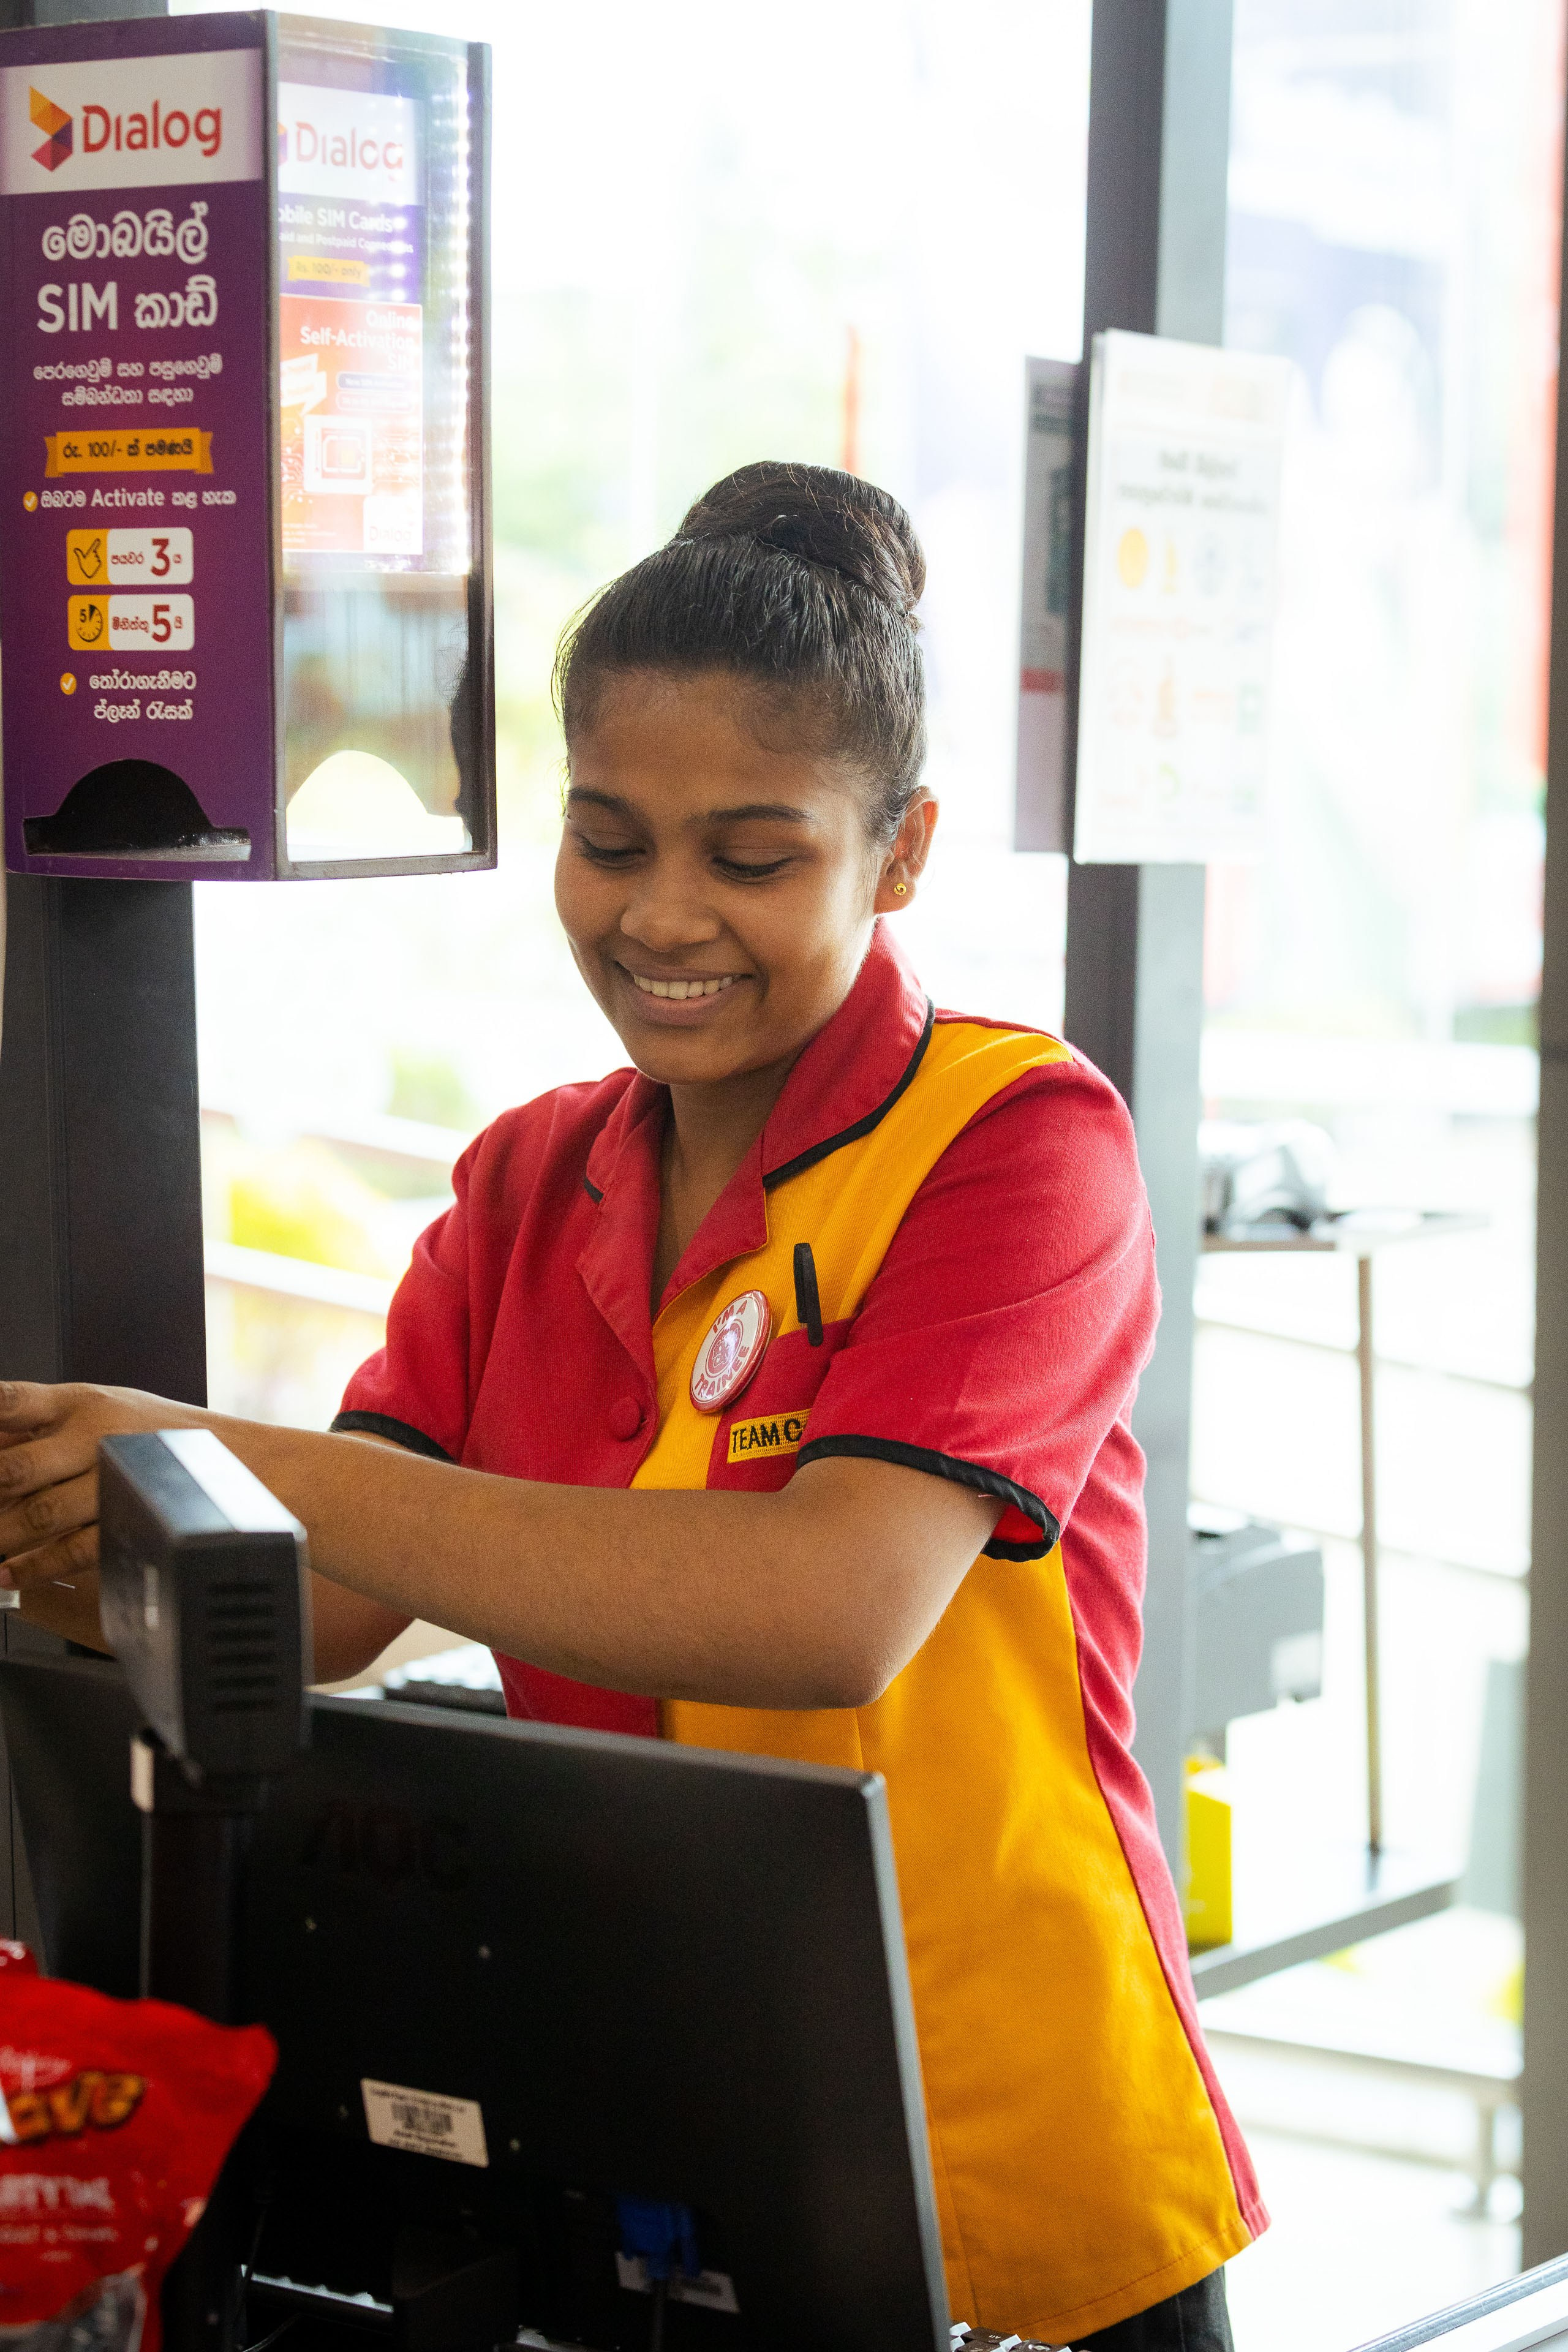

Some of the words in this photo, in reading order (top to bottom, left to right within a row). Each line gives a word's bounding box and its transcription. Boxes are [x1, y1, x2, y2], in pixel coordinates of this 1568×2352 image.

[83, 99, 222, 157] Dialog
[42, 202, 209, 264] මොබයිල්
[317, 208, 346, 228] SIM
[349, 211, 395, 233] Cards
[37, 281, 118, 333] SIM
[91, 488, 165, 507] Activate
[151, 538, 171, 577] 3
[151, 604, 172, 643] 5
[695, 1345, 750, 1398] TRAINEE
[732, 1422, 781, 1454] TEAM
